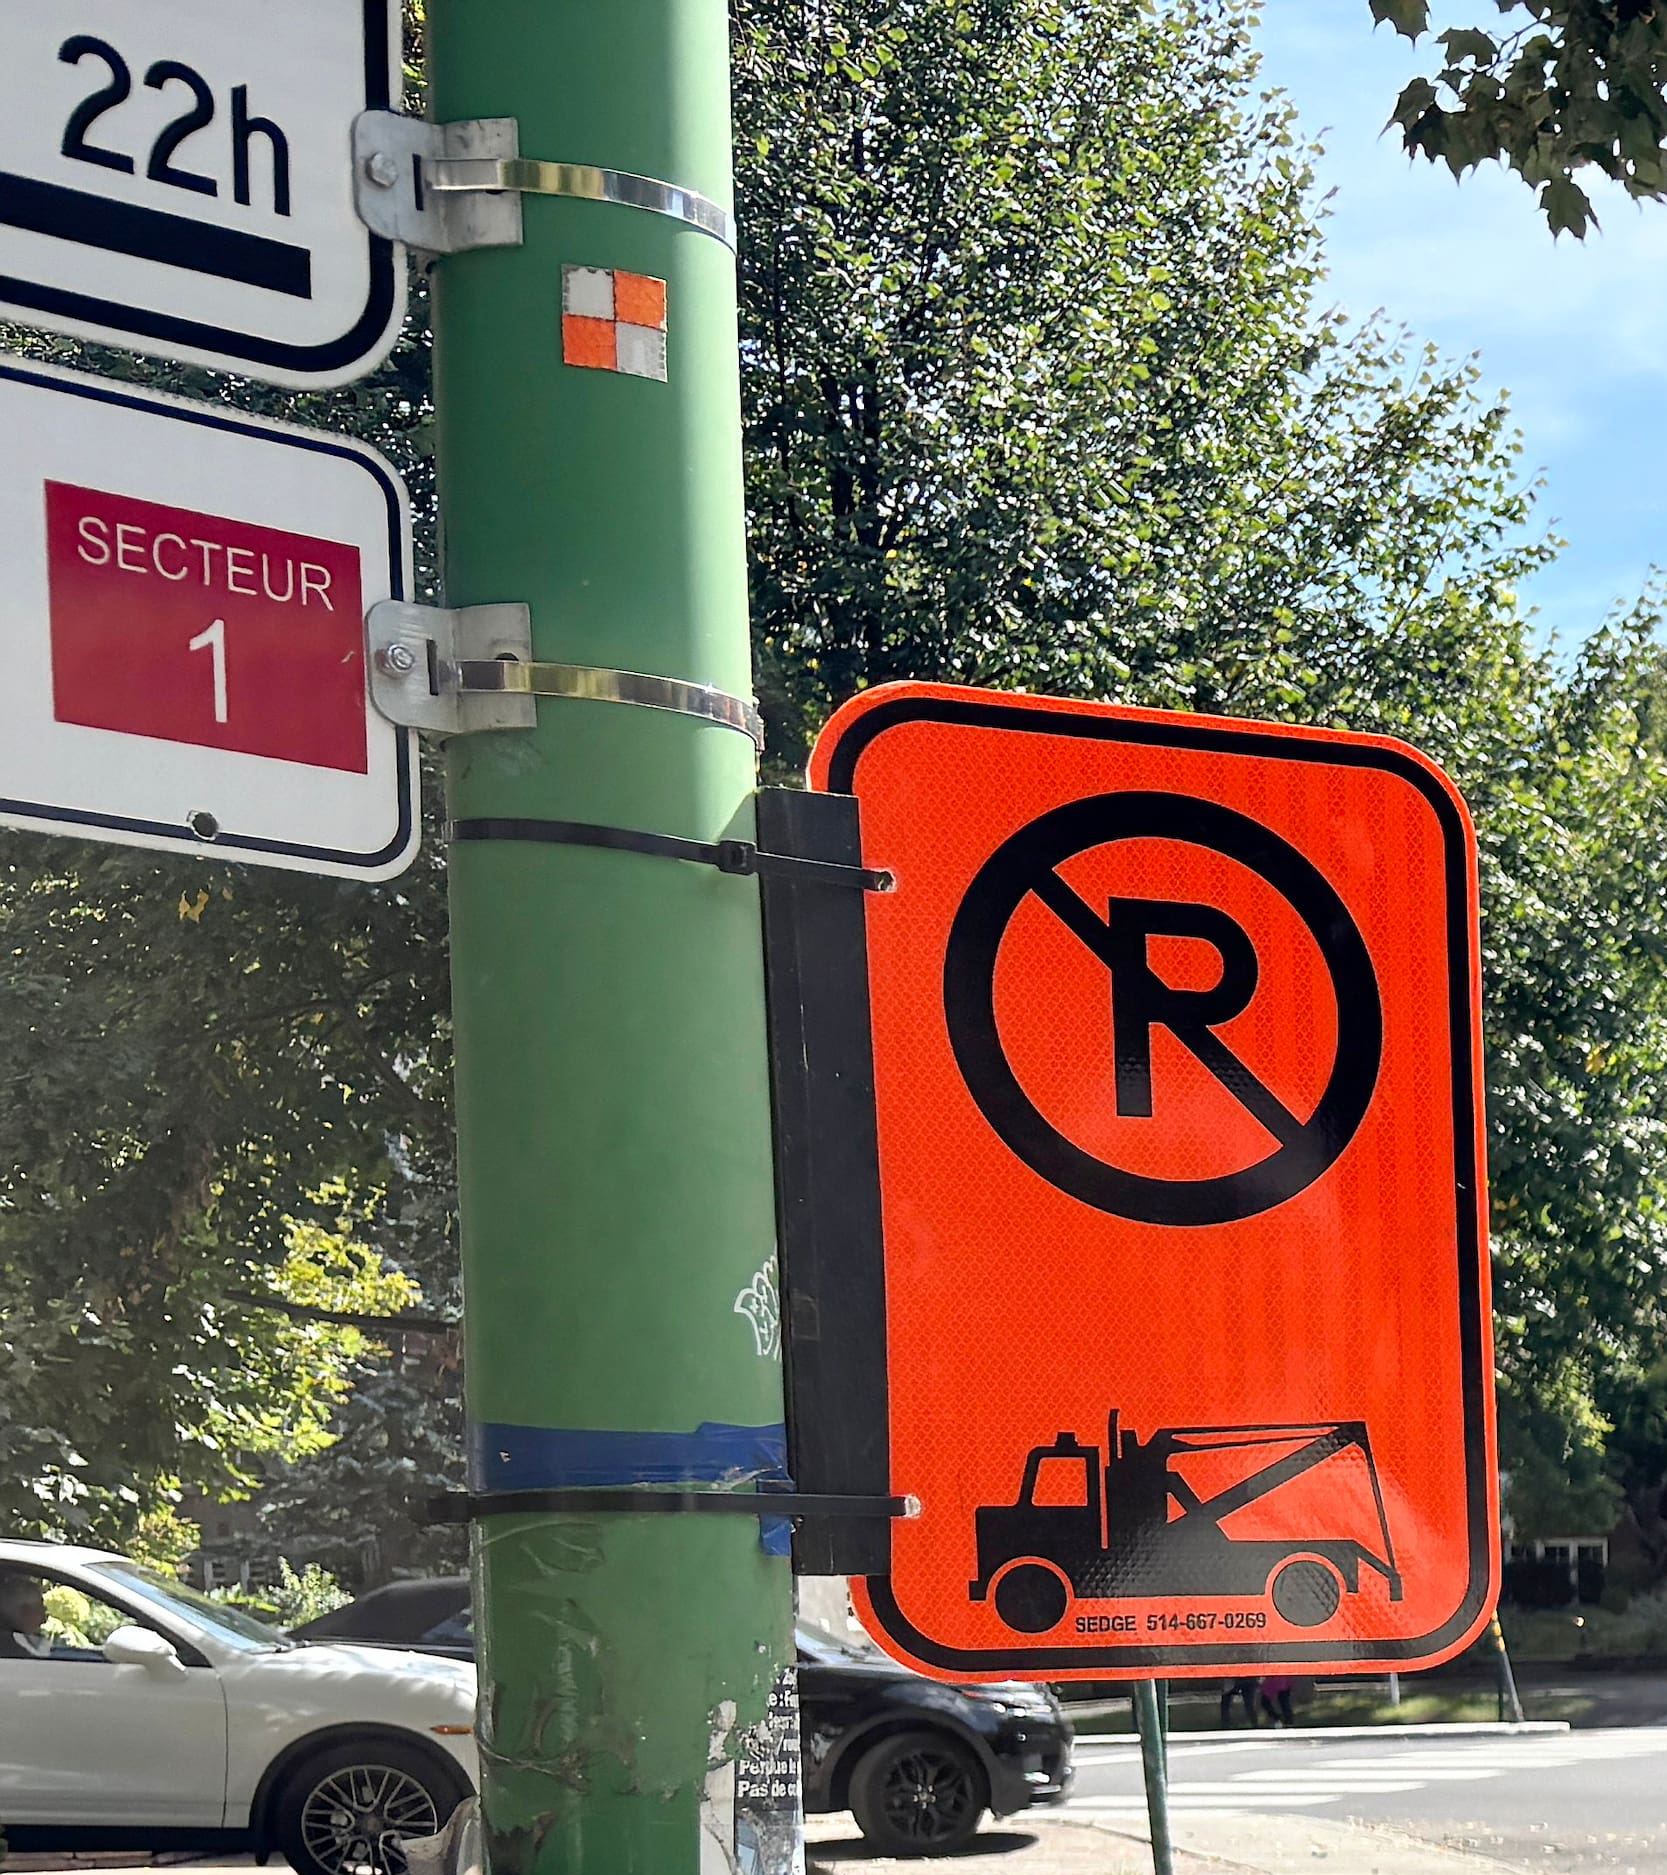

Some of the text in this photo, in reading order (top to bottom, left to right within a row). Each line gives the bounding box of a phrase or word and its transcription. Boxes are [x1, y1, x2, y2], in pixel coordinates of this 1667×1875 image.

[58, 35, 290, 215] 22h
[77, 517, 334, 610] SECTEUR
[188, 619, 229, 723] 1
[1075, 1613, 1266, 1632] SEDGE 514-667-0269
